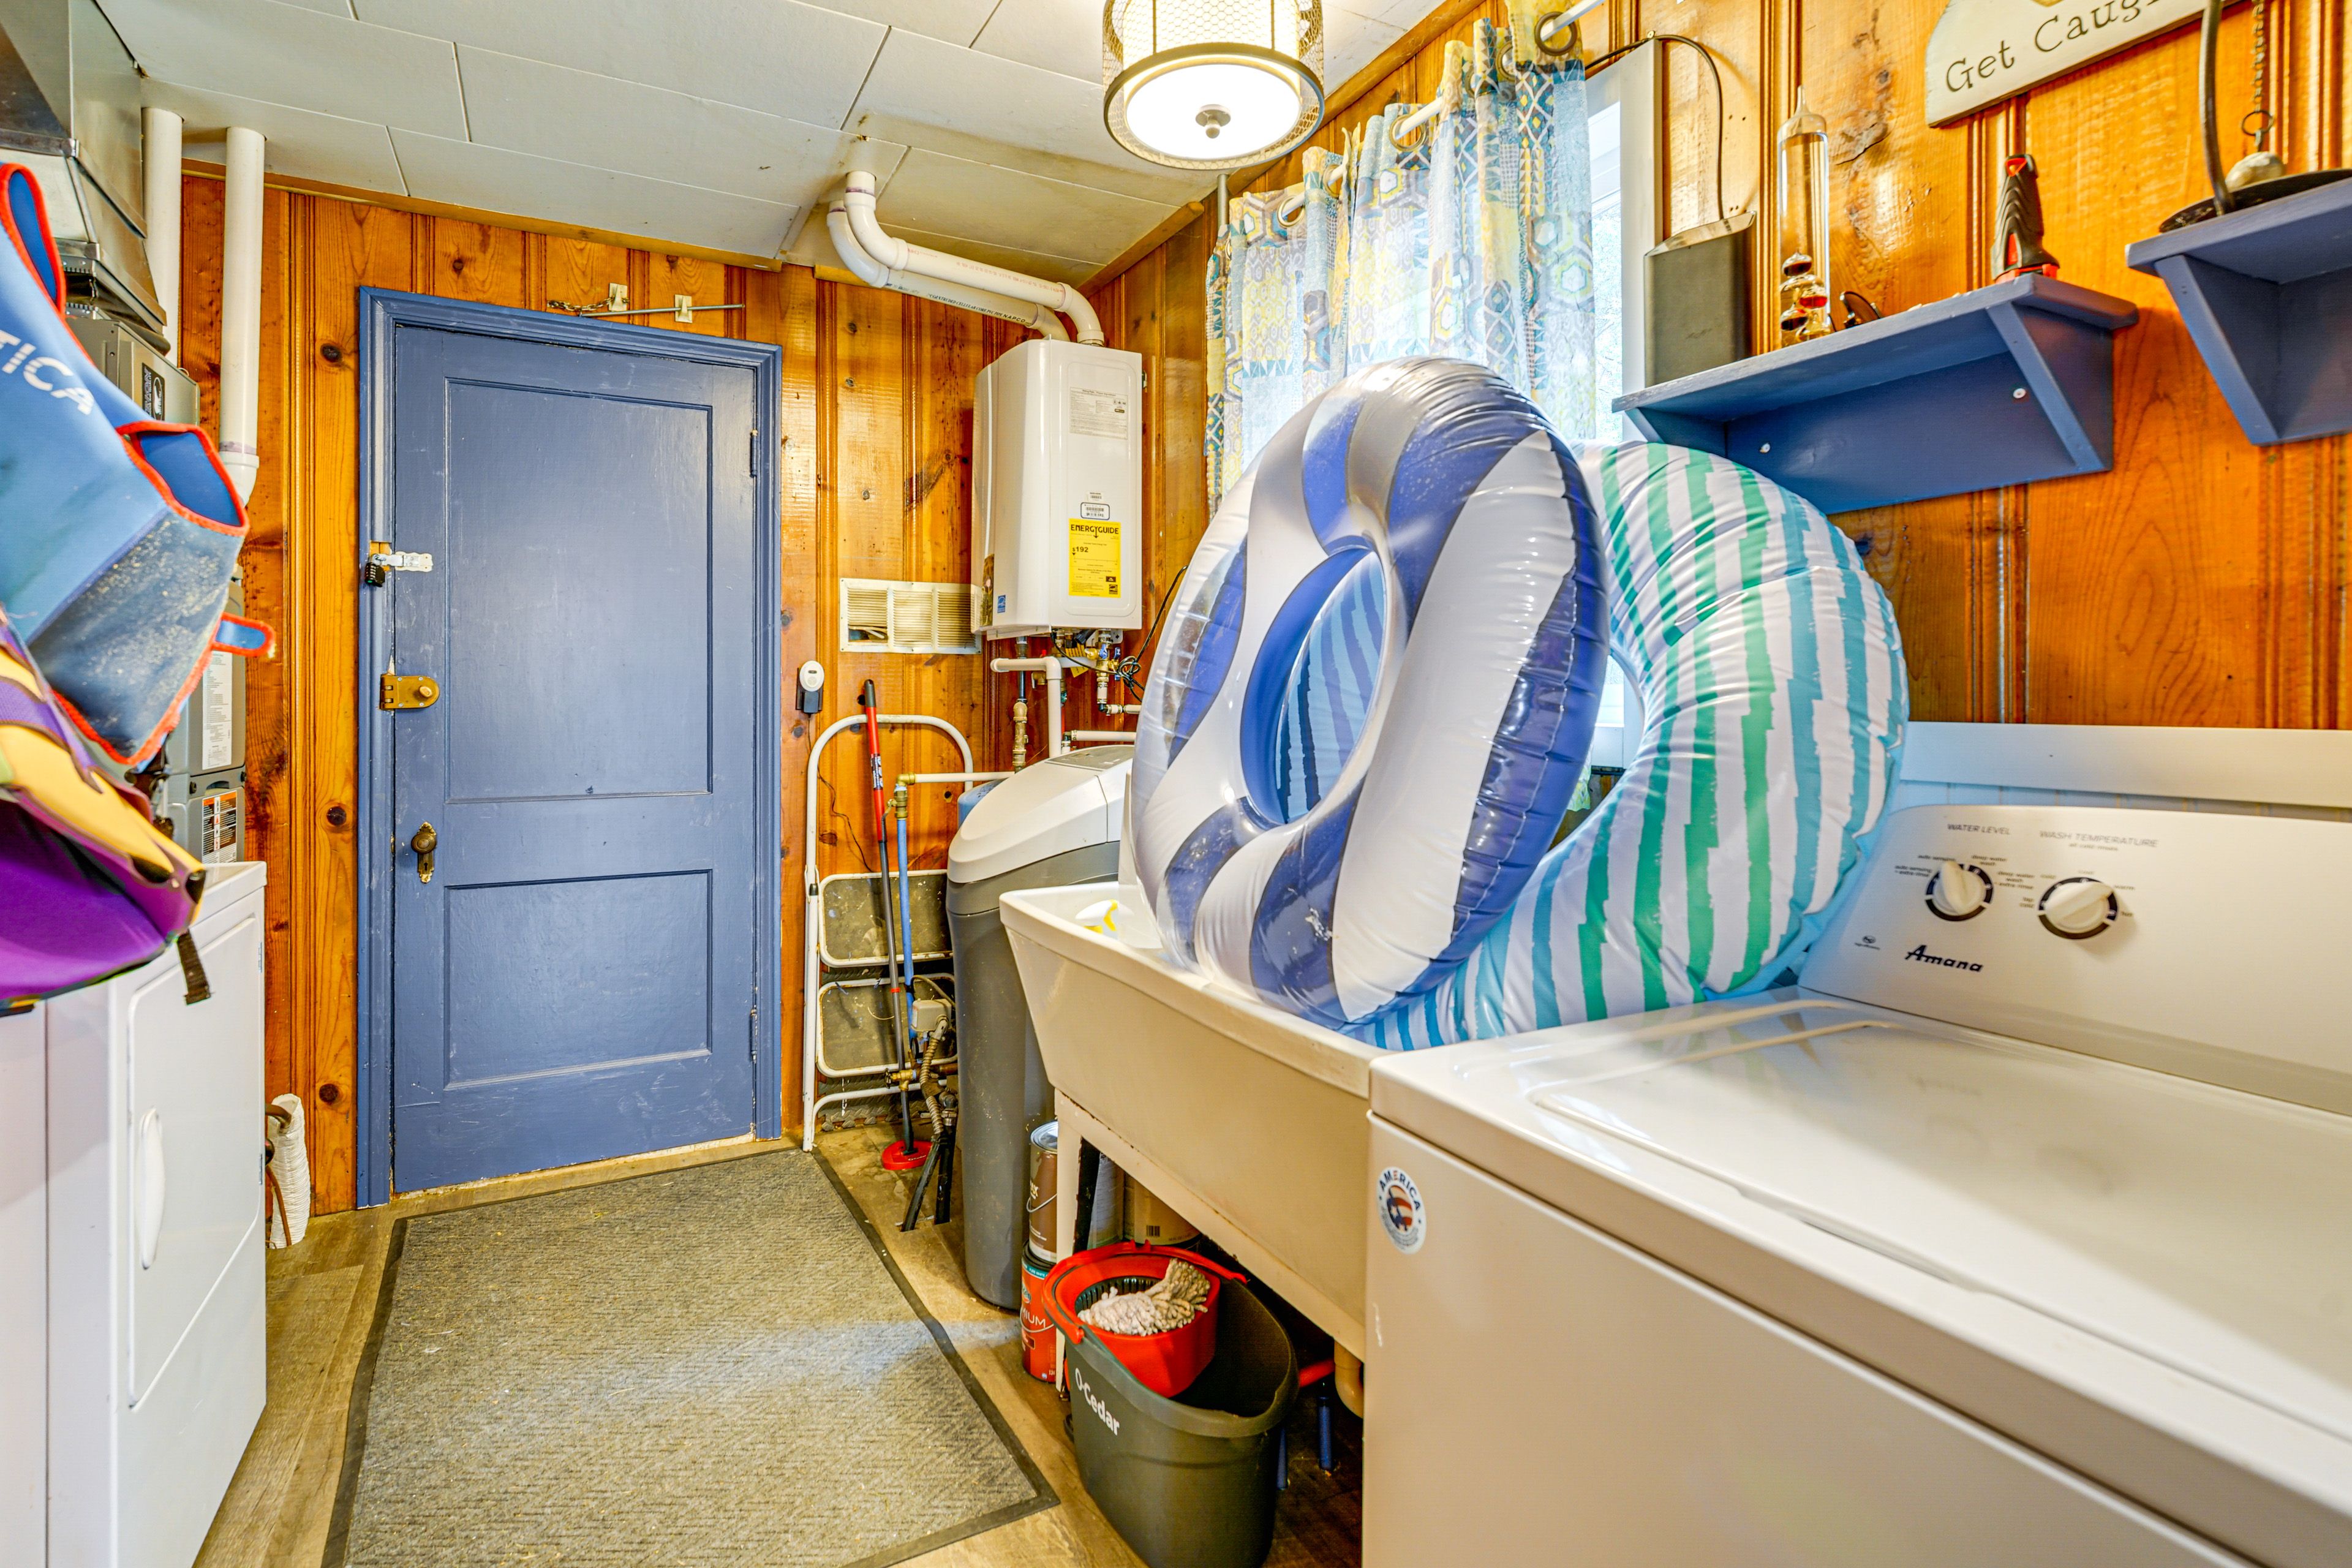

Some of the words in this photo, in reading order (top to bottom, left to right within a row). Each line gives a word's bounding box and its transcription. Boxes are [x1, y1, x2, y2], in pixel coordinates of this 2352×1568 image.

[1946, 40, 2015, 92] Get
[2035, 0, 2160, 53] Caug
[1003, 314, 1026, 323] NAPCO
[1071, 524, 1119, 537] ENERGYGUIDE
[1947, 823, 1980, 832] WATER
[1981, 826, 2010, 835] LEVEL
[2040, 831, 2072, 840] WASH
[2075, 833, 2158, 847] TEMPERATURE
[1905, 944, 1983, 971] Amana
[1379, 1170, 1421, 1211] AMERICA
[1076, 1368, 1120, 1436] O-Cedar
